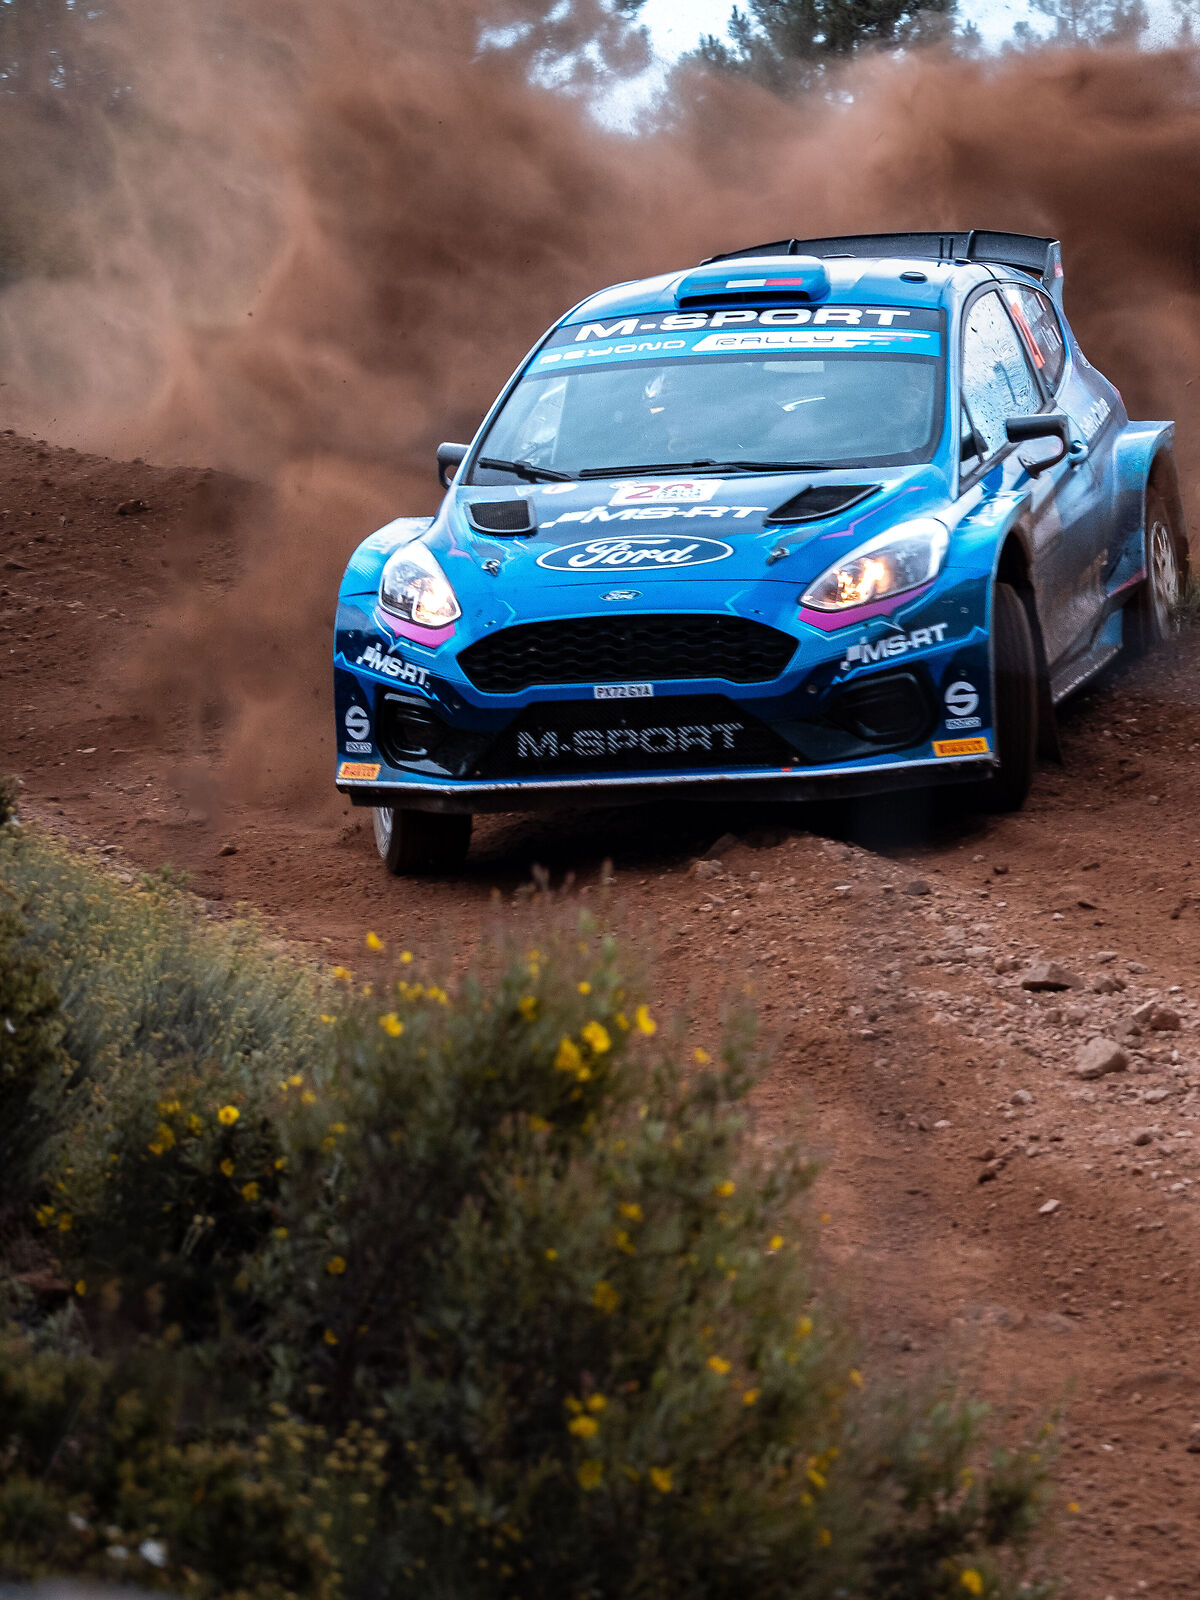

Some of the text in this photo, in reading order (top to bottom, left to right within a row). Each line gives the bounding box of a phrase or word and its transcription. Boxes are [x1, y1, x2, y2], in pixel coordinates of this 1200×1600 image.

[575, 307, 911, 342] M-SPORT
[539, 335, 835, 364] BEYOND RALLY
[580, 506, 769, 523] MS-RT
[568, 538, 700, 567] Ford
[861, 622, 949, 664] MS-RT
[517, 722, 744, 758] M-SPORT
